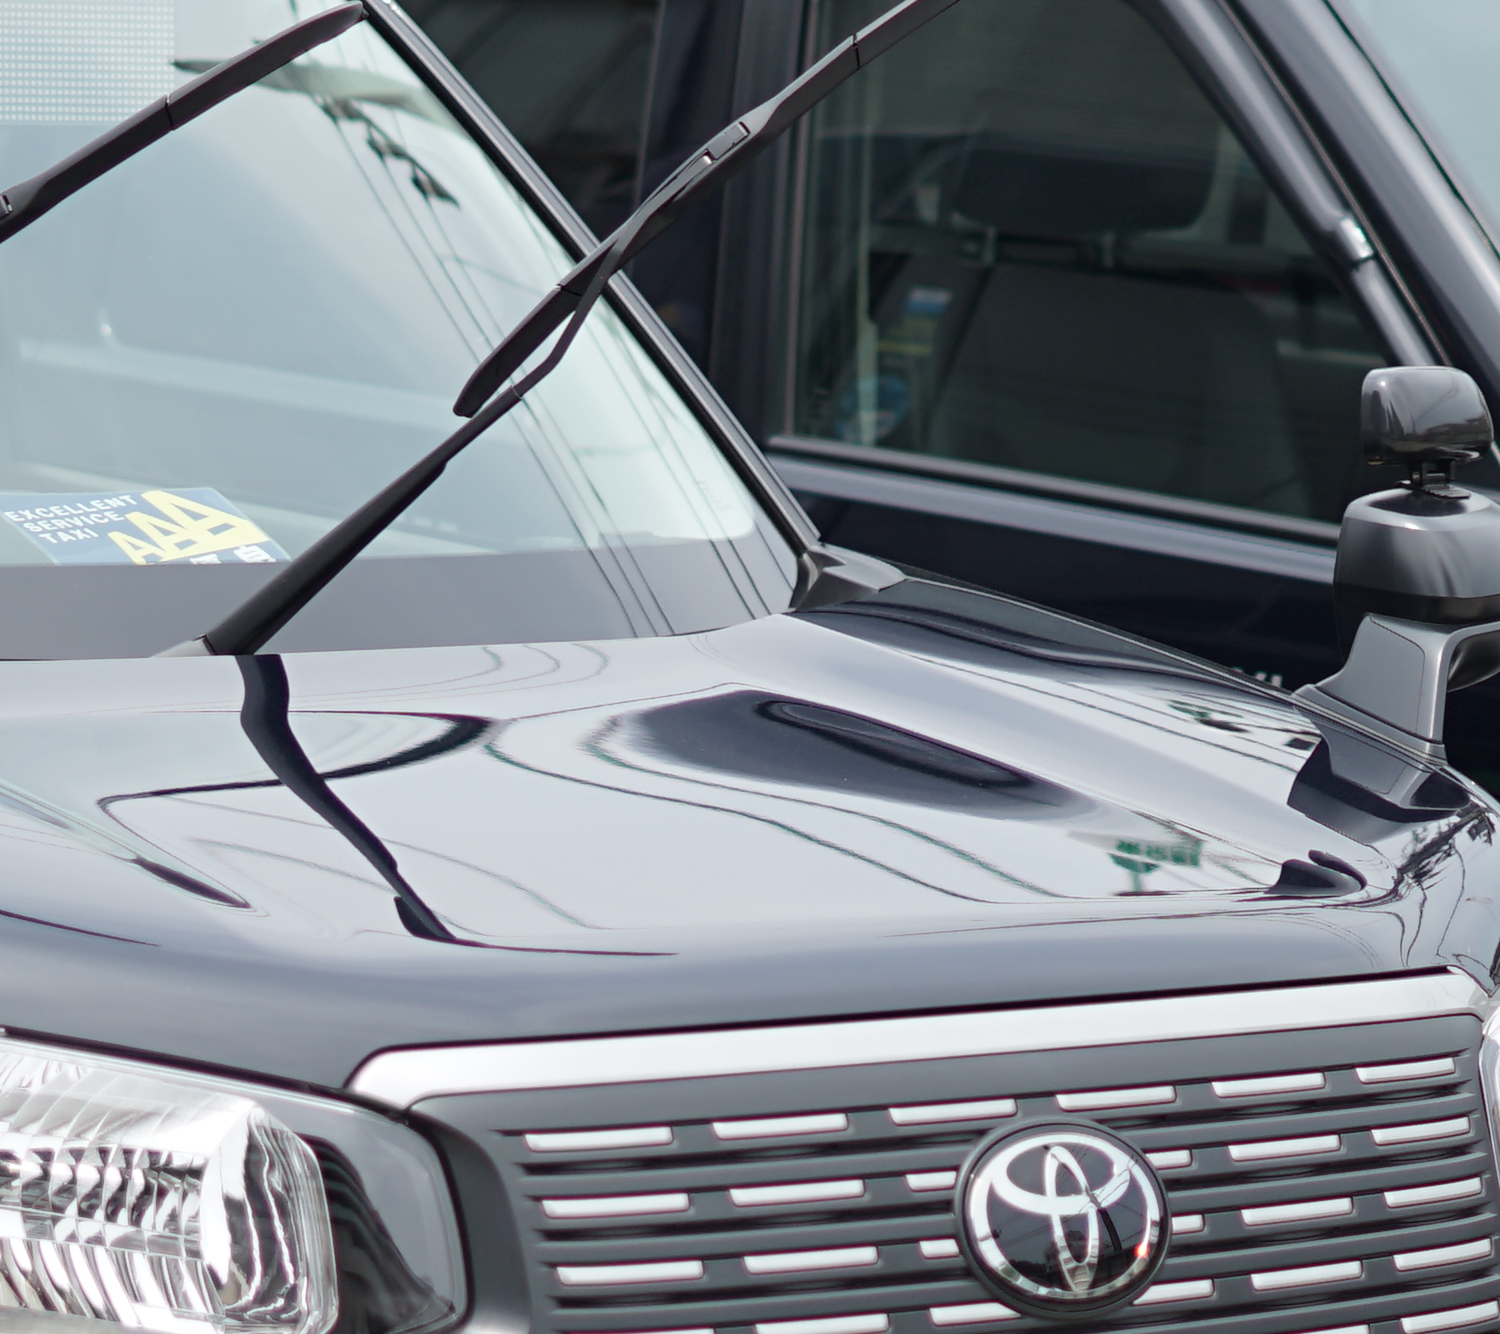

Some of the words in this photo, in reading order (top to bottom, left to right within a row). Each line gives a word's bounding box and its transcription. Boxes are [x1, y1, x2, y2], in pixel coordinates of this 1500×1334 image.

[4, 495, 138, 522] EXCELLENT
[23, 511, 126, 533] SERVICE
[39, 528, 100, 544] TAXI
